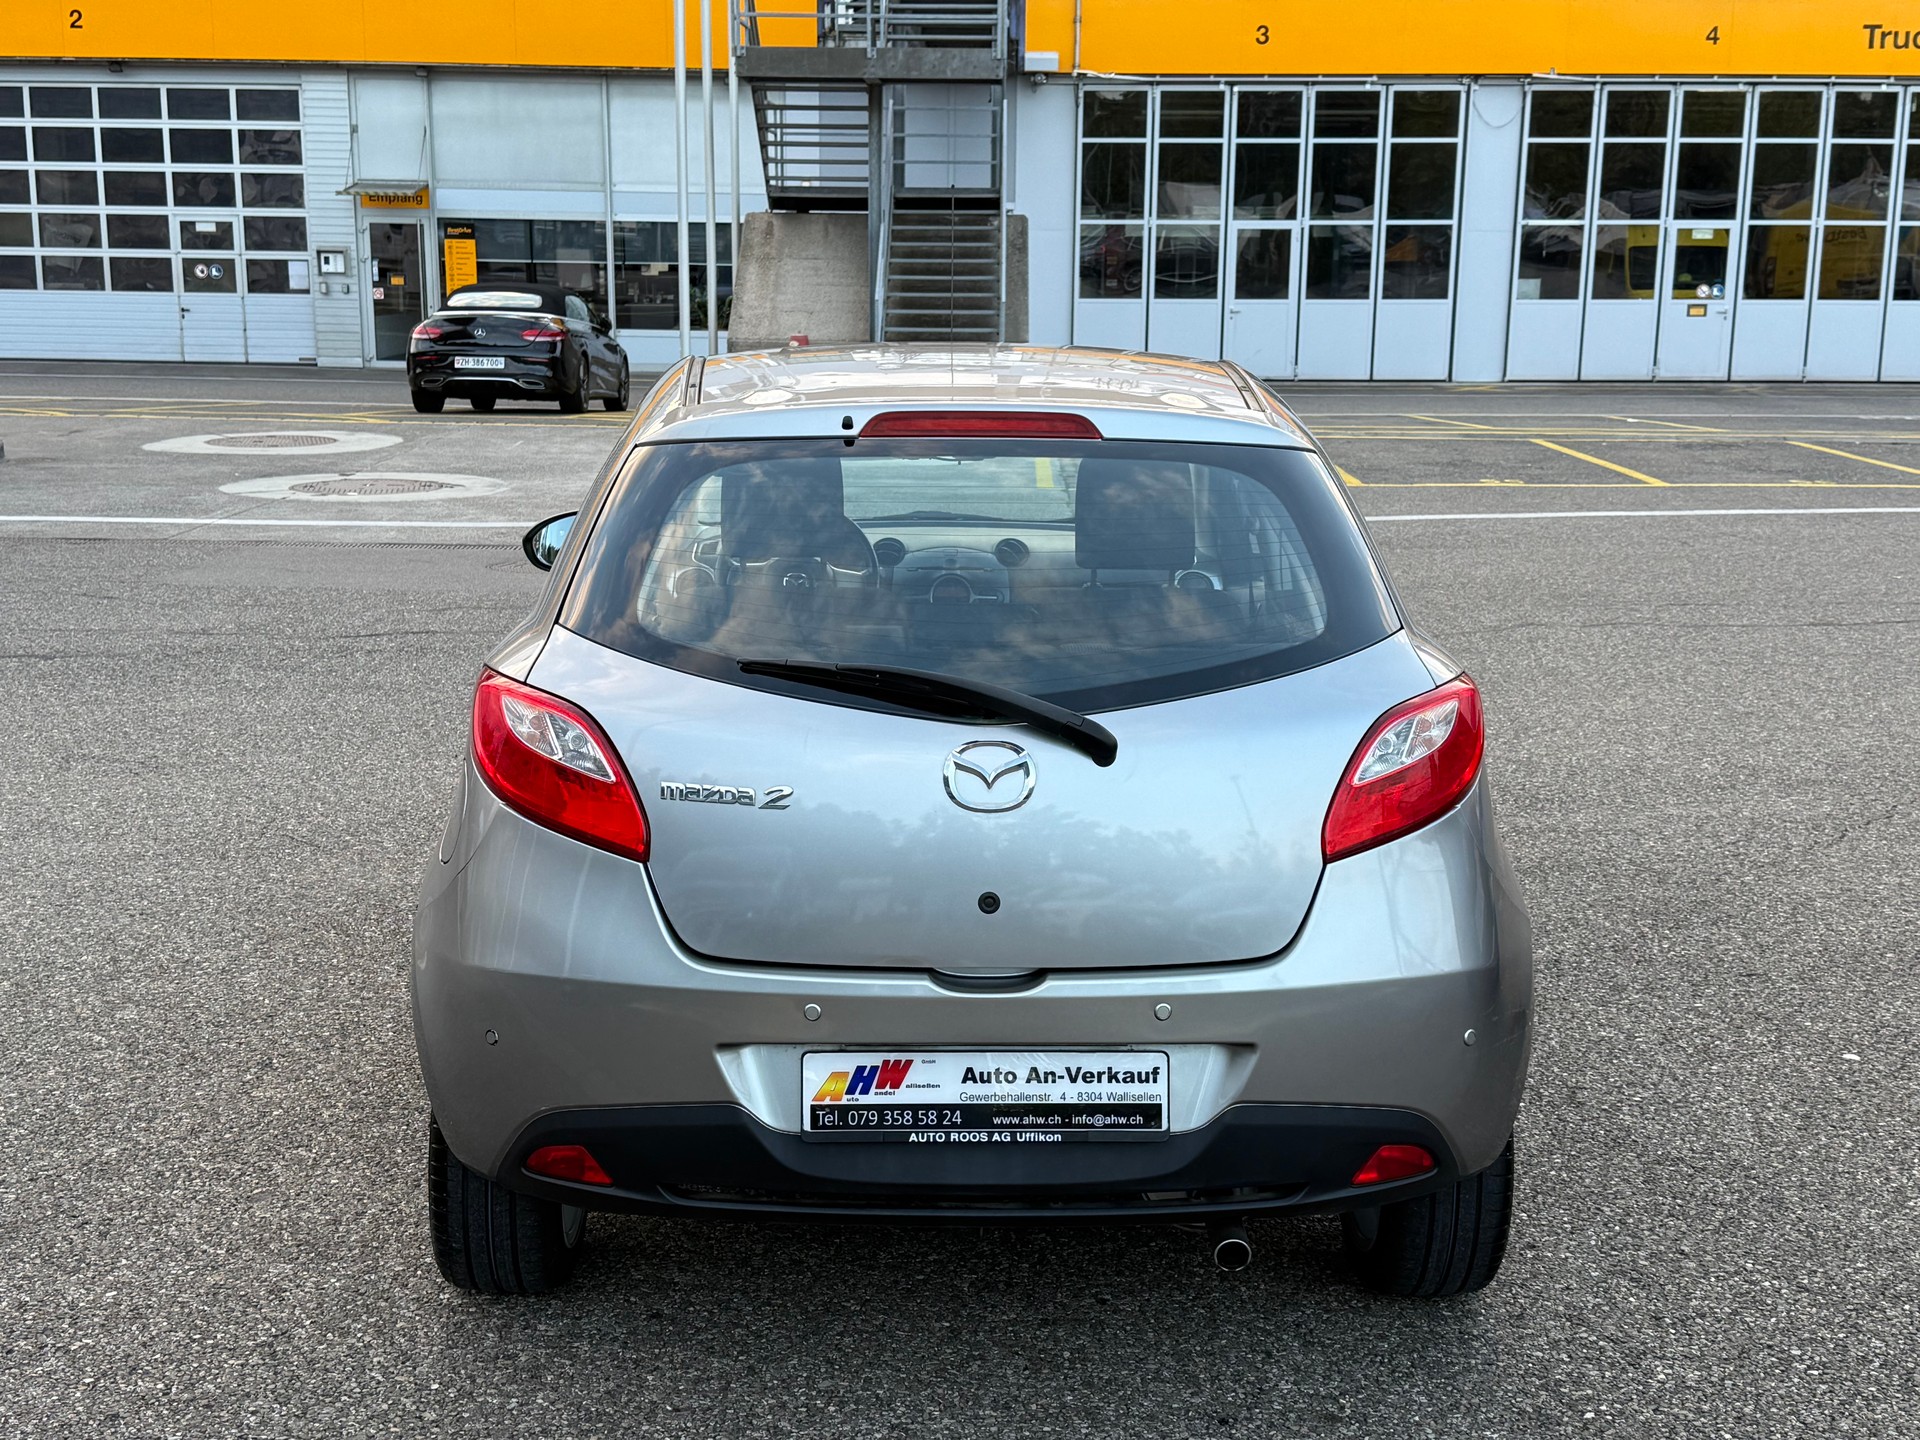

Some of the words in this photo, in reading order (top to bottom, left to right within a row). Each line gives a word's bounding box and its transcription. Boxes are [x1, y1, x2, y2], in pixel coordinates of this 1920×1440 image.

[69, 9, 83, 29] 2
[1256, 24, 1270, 45] 3
[1705, 25, 1720, 45] 4
[758, 785, 794, 810] 2
[961, 1066, 1018, 1084] Auto
[1025, 1066, 1161, 1084] An-Verkauf
[959, 1091, 1054, 1102] Gewerbehallenstr.
[1059, 1092, 1067, 1102] 4
[1076, 1092, 1103, 1102] 8304
[1106, 1091, 1162, 1102] Wallisellen
[816, 1111, 843, 1126] Tel.
[848, 1110, 878, 1125] 079
[883, 1110, 913, 1125] 358
[917, 1110, 938, 1125] 58
[942, 1110, 962, 1125] 24
[992, 1114, 1062, 1125] www.ahw.ch
[1072, 1114, 1144, 1127] info@ahw.ch
[908, 1132, 946, 1143] AUTO
[950, 1132, 989, 1143] ROOS
[991, 1132, 1011, 1143] AG
[1016, 1132, 1062, 1142] Uffikon
